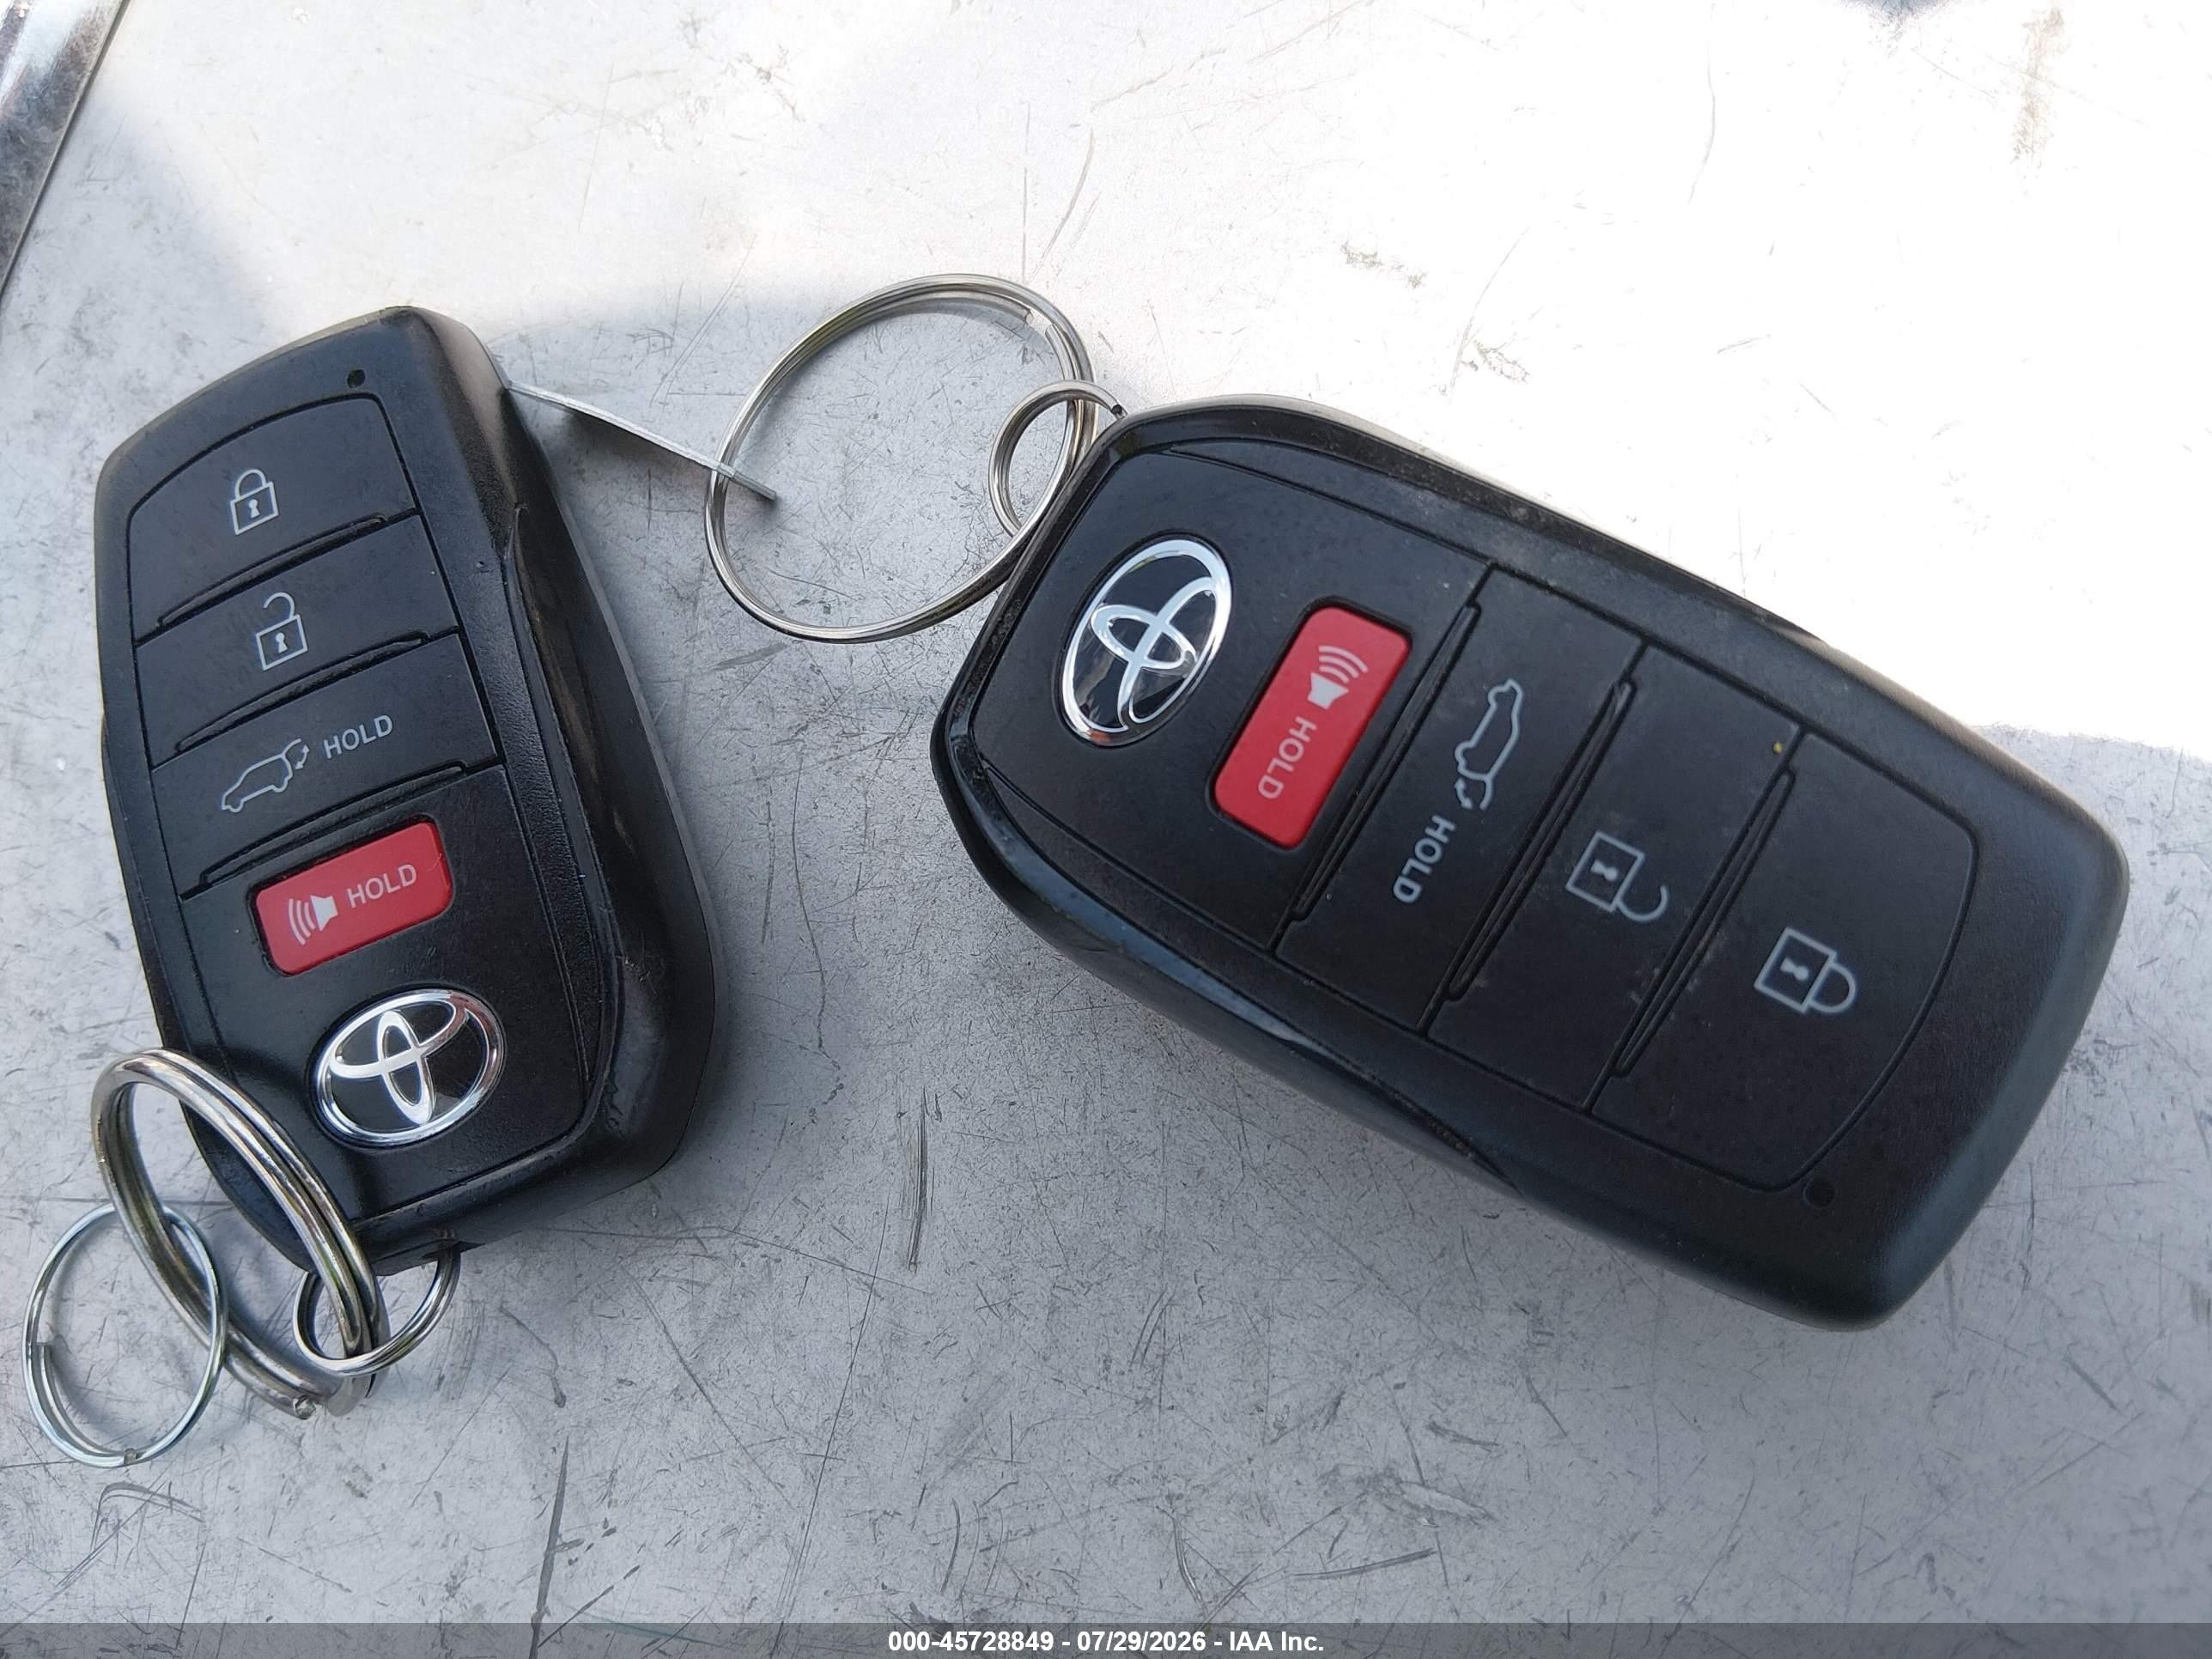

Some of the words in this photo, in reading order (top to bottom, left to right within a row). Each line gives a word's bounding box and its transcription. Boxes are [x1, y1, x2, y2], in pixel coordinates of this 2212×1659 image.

[323, 714, 392, 759] HOLD
[1257, 715, 1317, 799] HOLD
[346, 864, 417, 908] HOLD
[1393, 816, 1455, 903] HOLD
